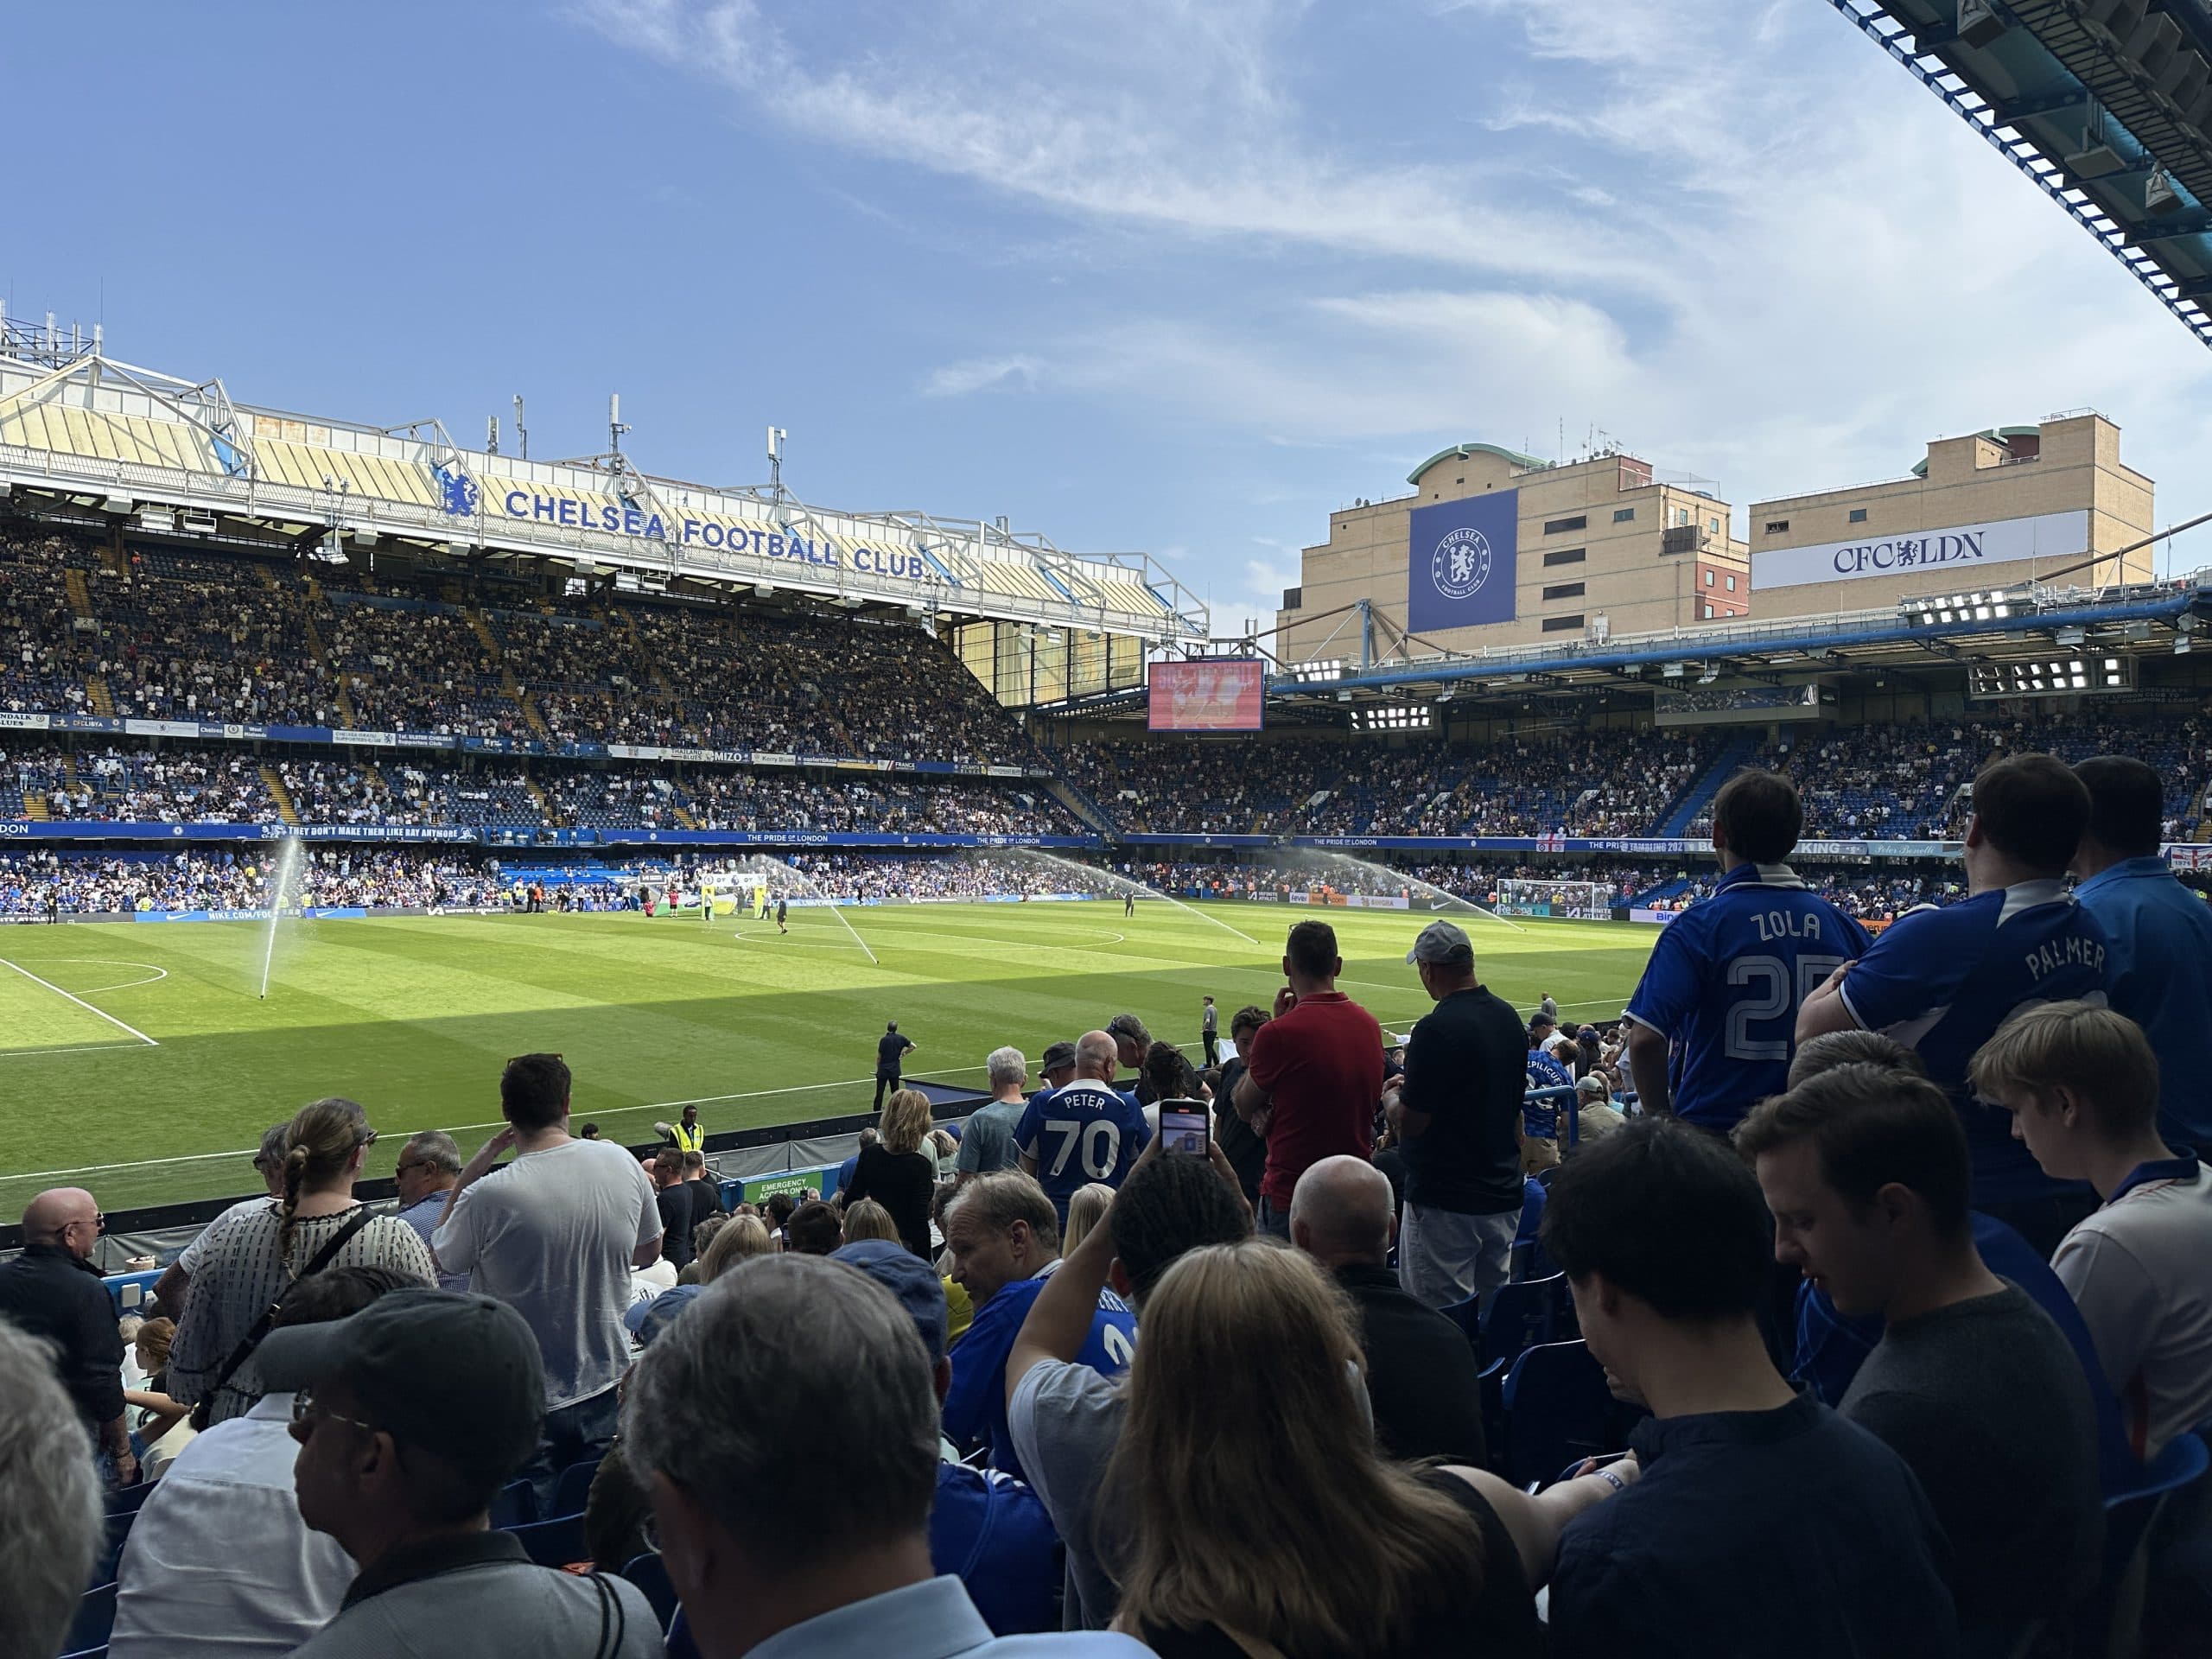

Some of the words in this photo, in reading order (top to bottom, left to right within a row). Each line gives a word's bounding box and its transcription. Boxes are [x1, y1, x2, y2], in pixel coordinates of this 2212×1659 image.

[506, 491, 666, 539] CHELSEA
[683, 519, 838, 567] FOOTBALL
[854, 547, 923, 578] CLUB
[1442, 531, 1480, 549] CHELSEA
[1834, 543, 1893, 574] CFC
[1918, 531, 1986, 564] LDN
[1441, 584, 1465, 595] FOOTBALL
[1467, 579, 1480, 592] CLUB
[715, 752, 742, 762] MIZO
[288, 826, 309, 836] THEY
[311, 826, 336, 836] DON'T
[339, 826, 361, 836] MAKE
[363, 827, 385, 836] THEM
[386, 827, 404, 836] LIKE
[405, 828, 421, 836] RAY
[421, 829, 457, 838] ANYMORE
[1589, 841, 1604, 849] THE
[1801, 842, 1840, 854] KING
[1750, 910, 1821, 941] ZOLA
[2024, 937, 2105, 981] PALMER
[1065, 1094, 1106, 1110] PETER
[1046, 1119, 1120, 1179] 70
[761, 1178, 806, 1192] EMERGENCY
